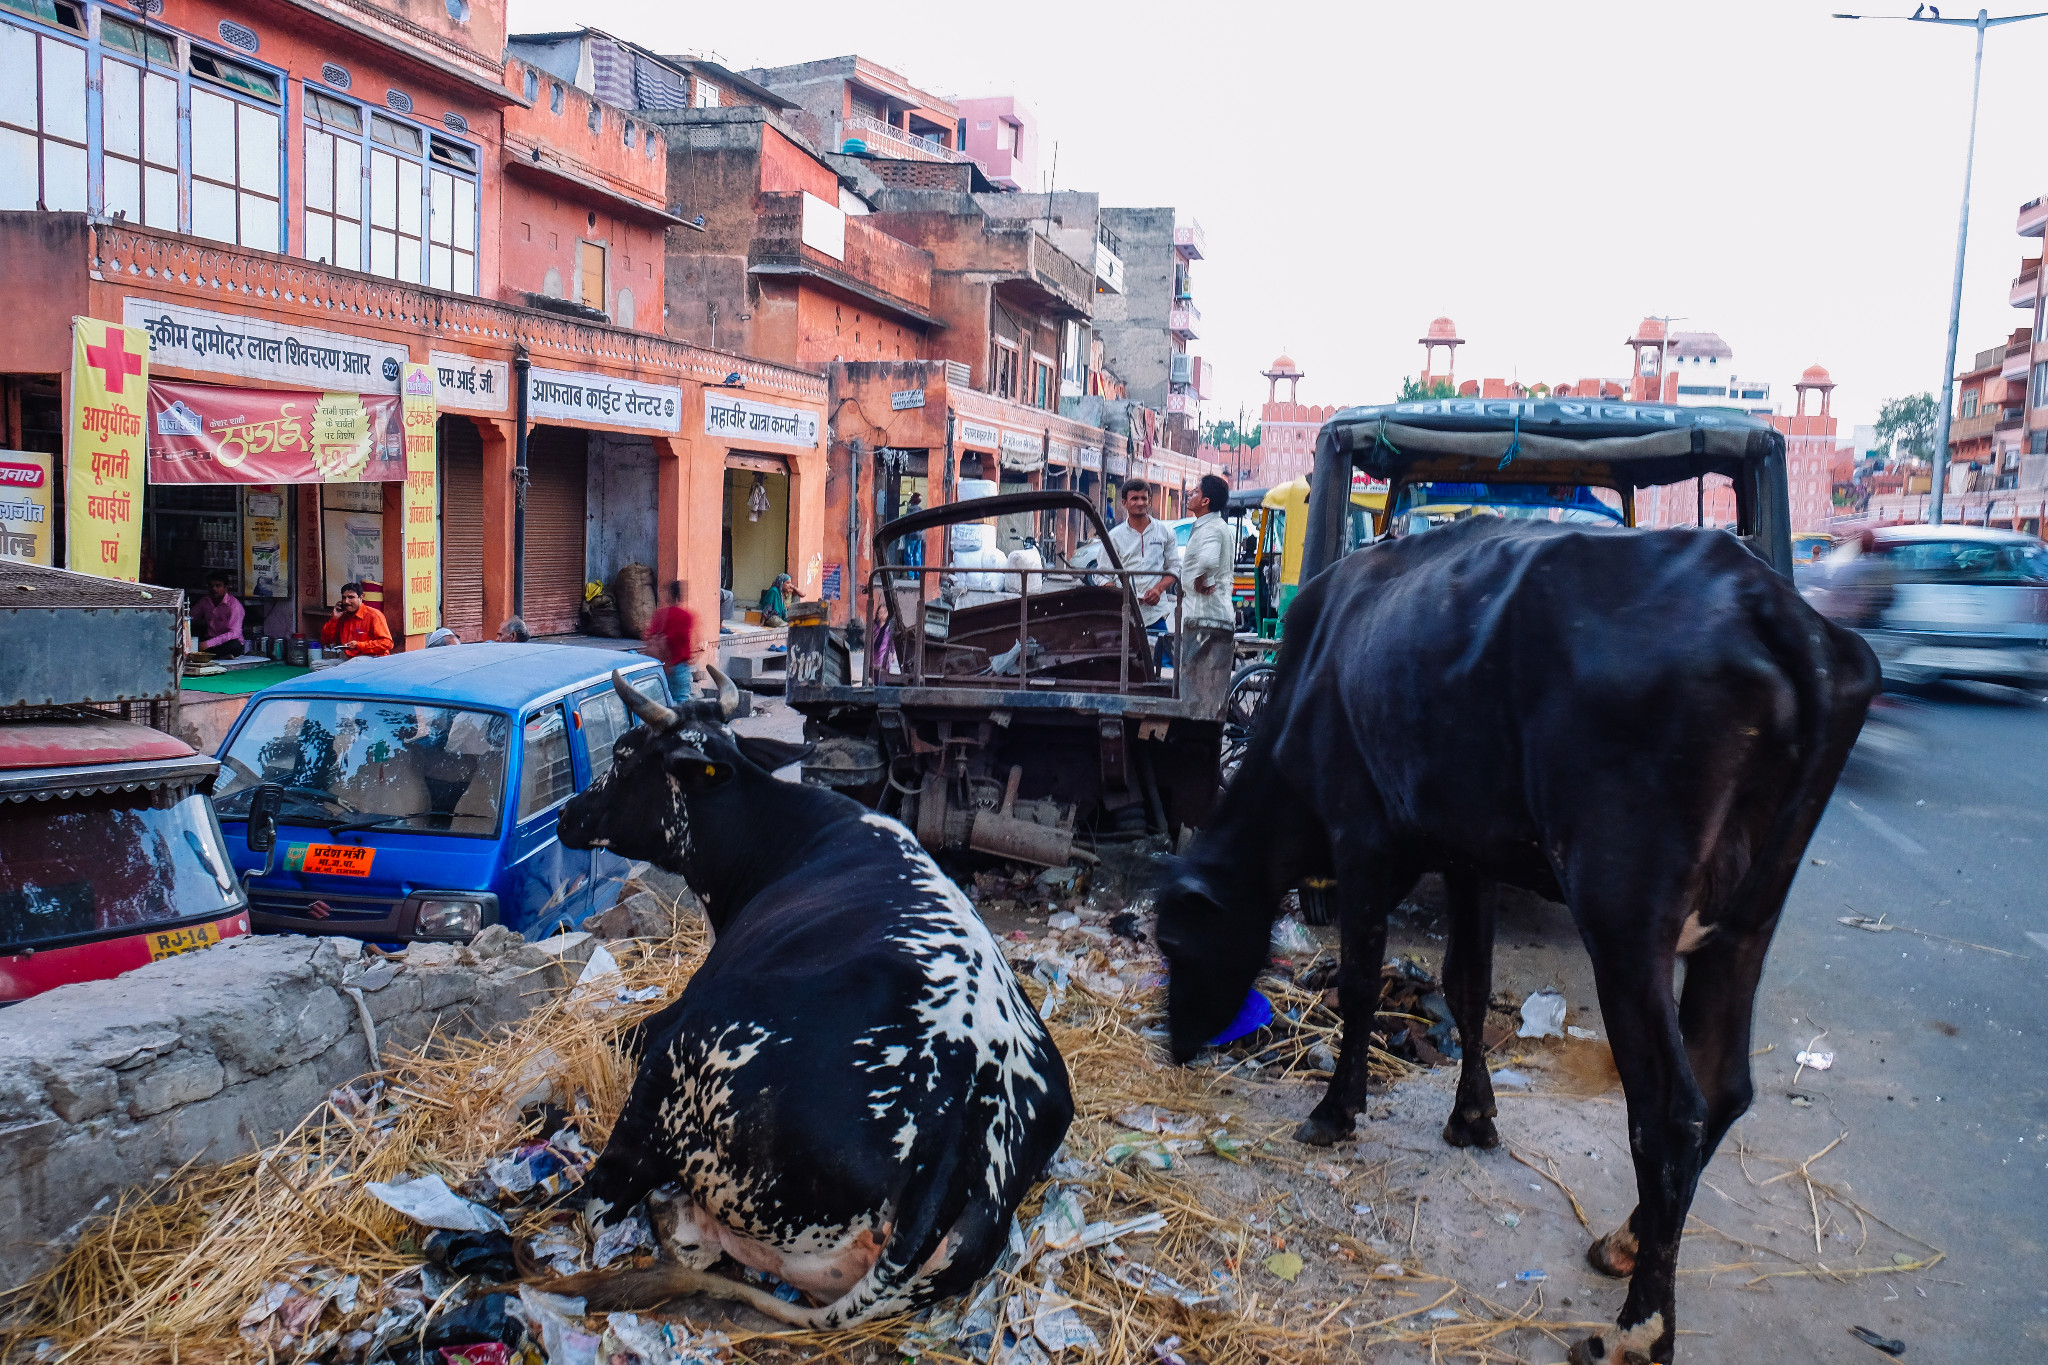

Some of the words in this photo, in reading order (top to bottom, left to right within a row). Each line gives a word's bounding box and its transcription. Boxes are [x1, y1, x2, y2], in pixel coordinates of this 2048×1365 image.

[191, 325, 245, 360] दामोदर
[247, 335, 282, 363] लाल
[284, 337, 341, 371] शिवचरण
[342, 350, 371, 375] अत्तार
[384, 363, 397, 377] 322
[532, 379, 583, 407] आफताब
[586, 384, 622, 415] काईट
[625, 389, 661, 417] सेन्टर
[326, 418, 333, 427] के
[711, 402, 747, 429] महावीर
[749, 412, 771, 432] यात्रा
[771, 413, 799, 436] कम्पनी
[337, 430, 355, 440] विशेष
[426, 435, 433, 453] का
[91, 449, 130, 485] यूनानी
[320, 444, 361, 477] छूट
[101, 533, 120, 563] एवं
[314, 846, 341, 858] प्रदेश
[343, 847, 366, 860] मंत्री
[157, 927, 209, 950] RJ-14
